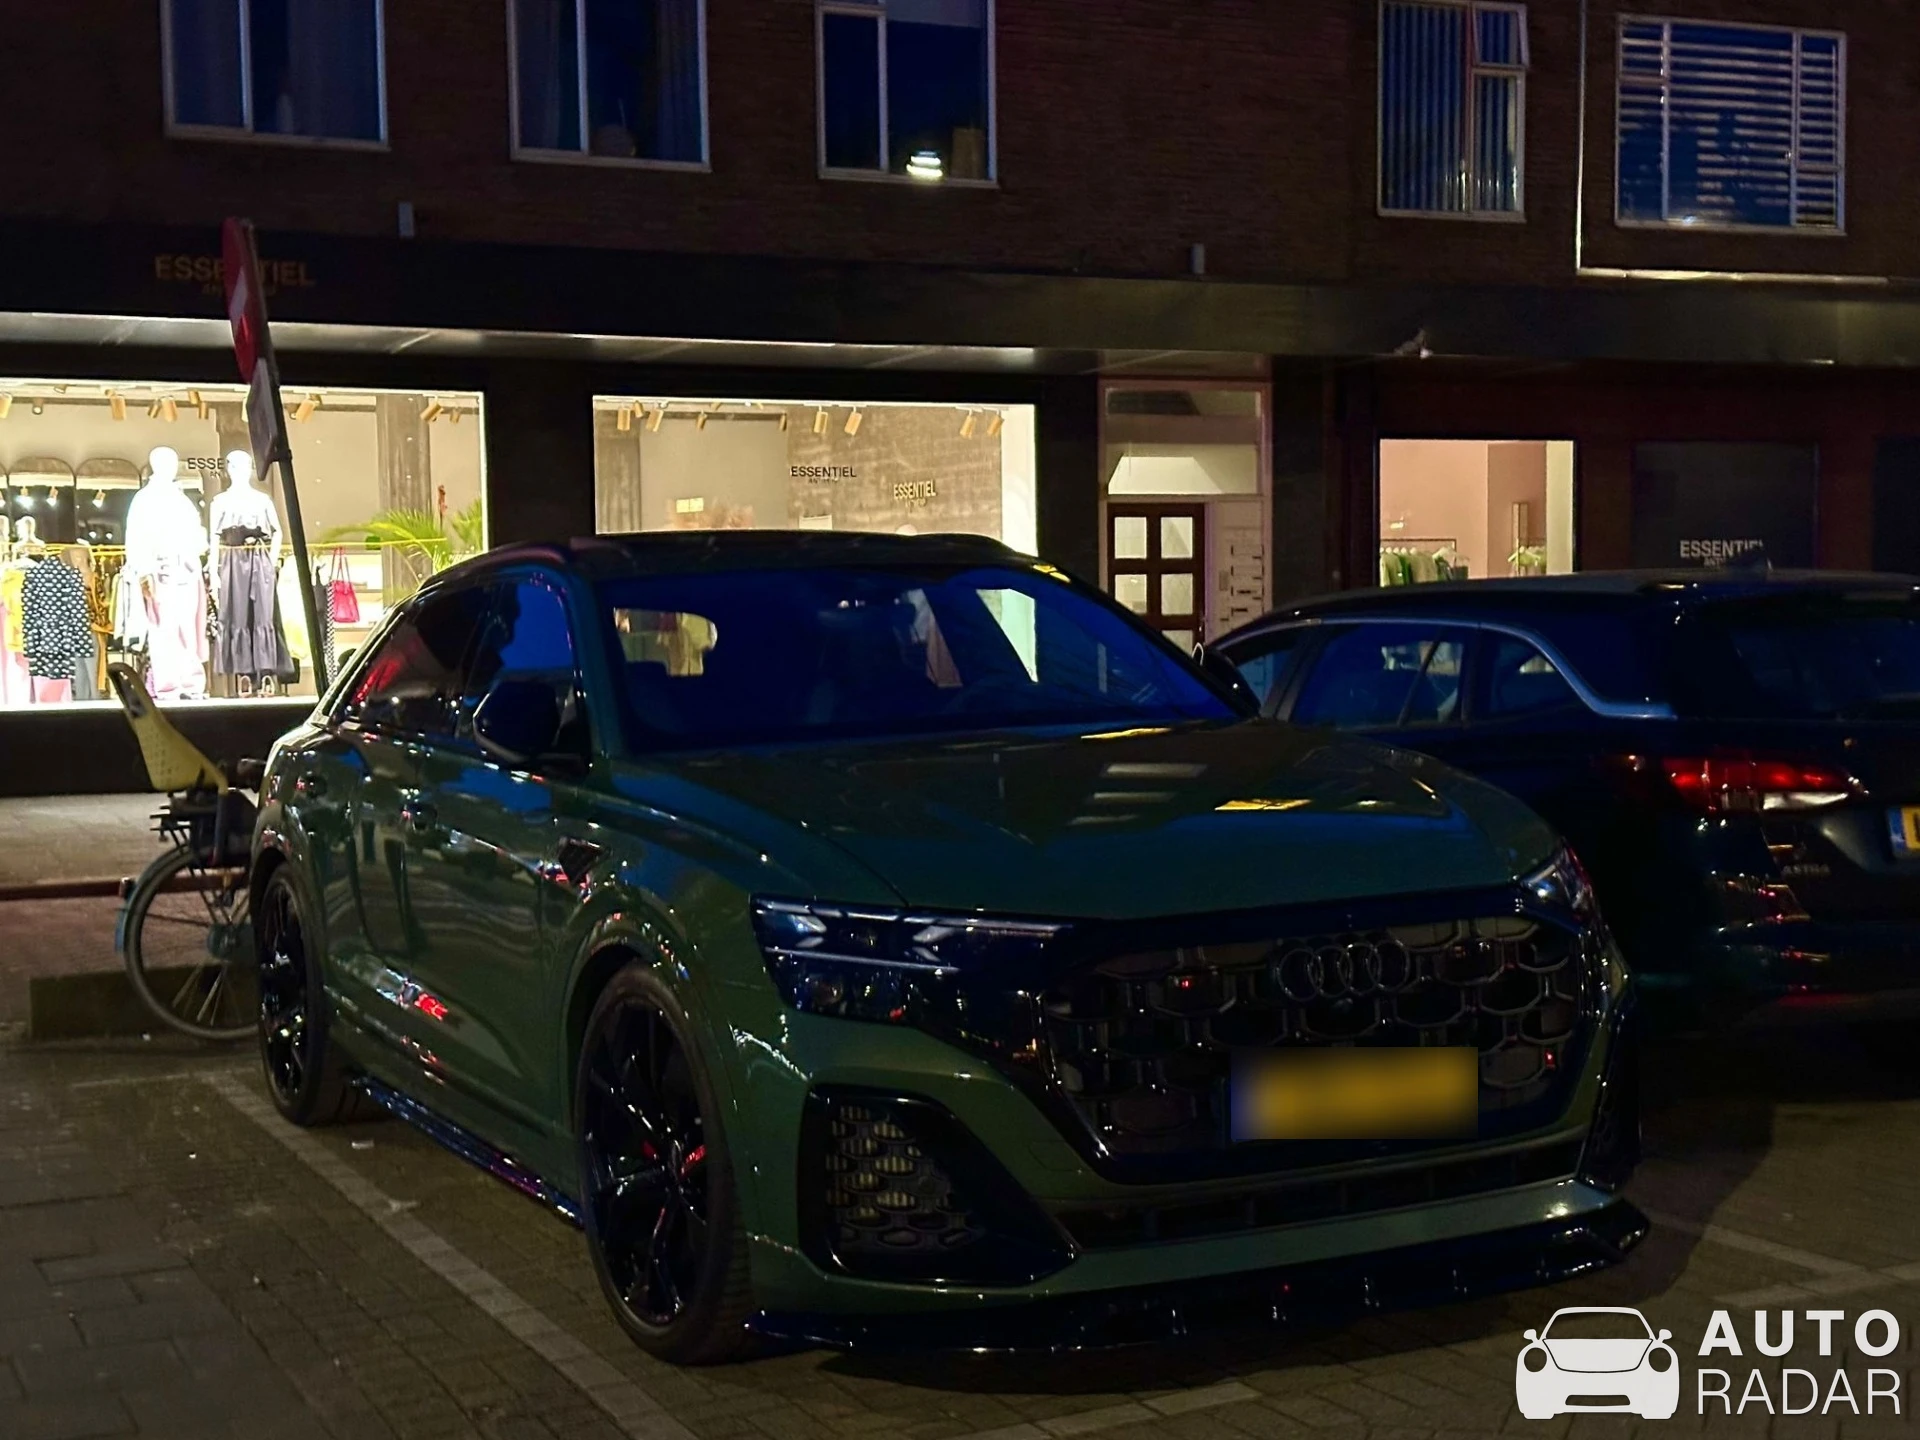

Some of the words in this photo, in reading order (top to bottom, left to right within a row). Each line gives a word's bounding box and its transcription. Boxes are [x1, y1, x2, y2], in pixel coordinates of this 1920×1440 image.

[154, 254, 317, 287] ESSETIEL
[791, 465, 857, 478] ESSENTIEL
[893, 480, 937, 500] ESSENTIEL
